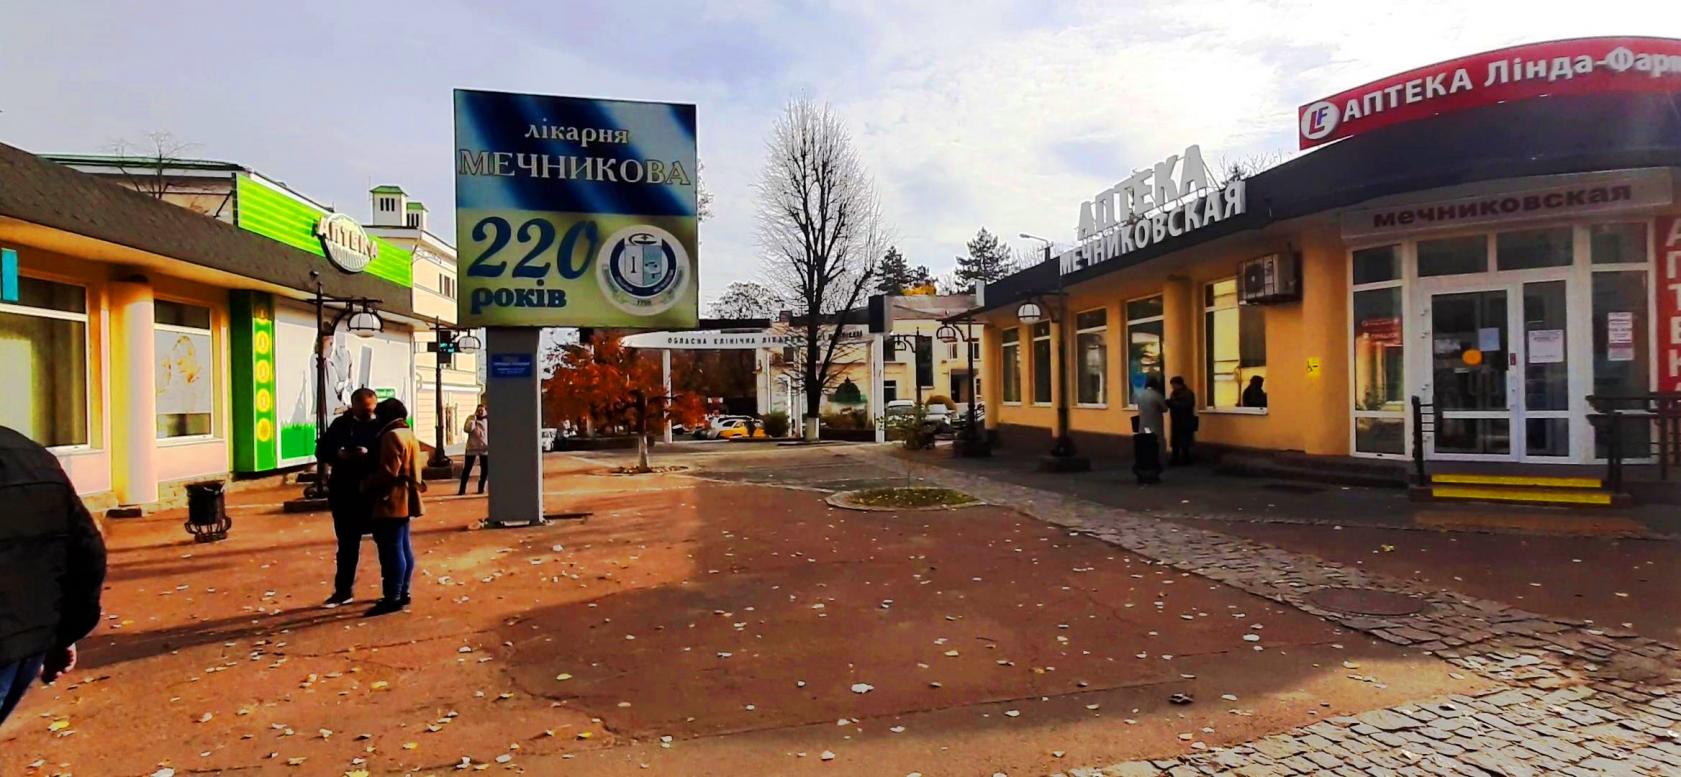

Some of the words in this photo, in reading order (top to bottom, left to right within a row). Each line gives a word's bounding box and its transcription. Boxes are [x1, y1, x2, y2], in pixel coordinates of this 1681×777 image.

[1343, 68, 1473, 122] АПТЕКА
[524, 117, 629, 147] лікарня
[459, 149, 690, 185] МЕЧНИКОВА
[1077, 144, 1208, 240] АПТЕКА
[1373, 183, 1632, 228] мечниковская
[319, 215, 378, 261] АПТЕКА
[467, 216, 599, 280] 220
[1059, 179, 1246, 276] МЕЧНИКОВСКАЯ
[470, 280, 567, 315] років
[667, 337, 707, 345] ОБЛАСНА
[713, 337, 756, 345] КЛІНІЧНА
[761, 335, 804, 344] ЛІКАР
